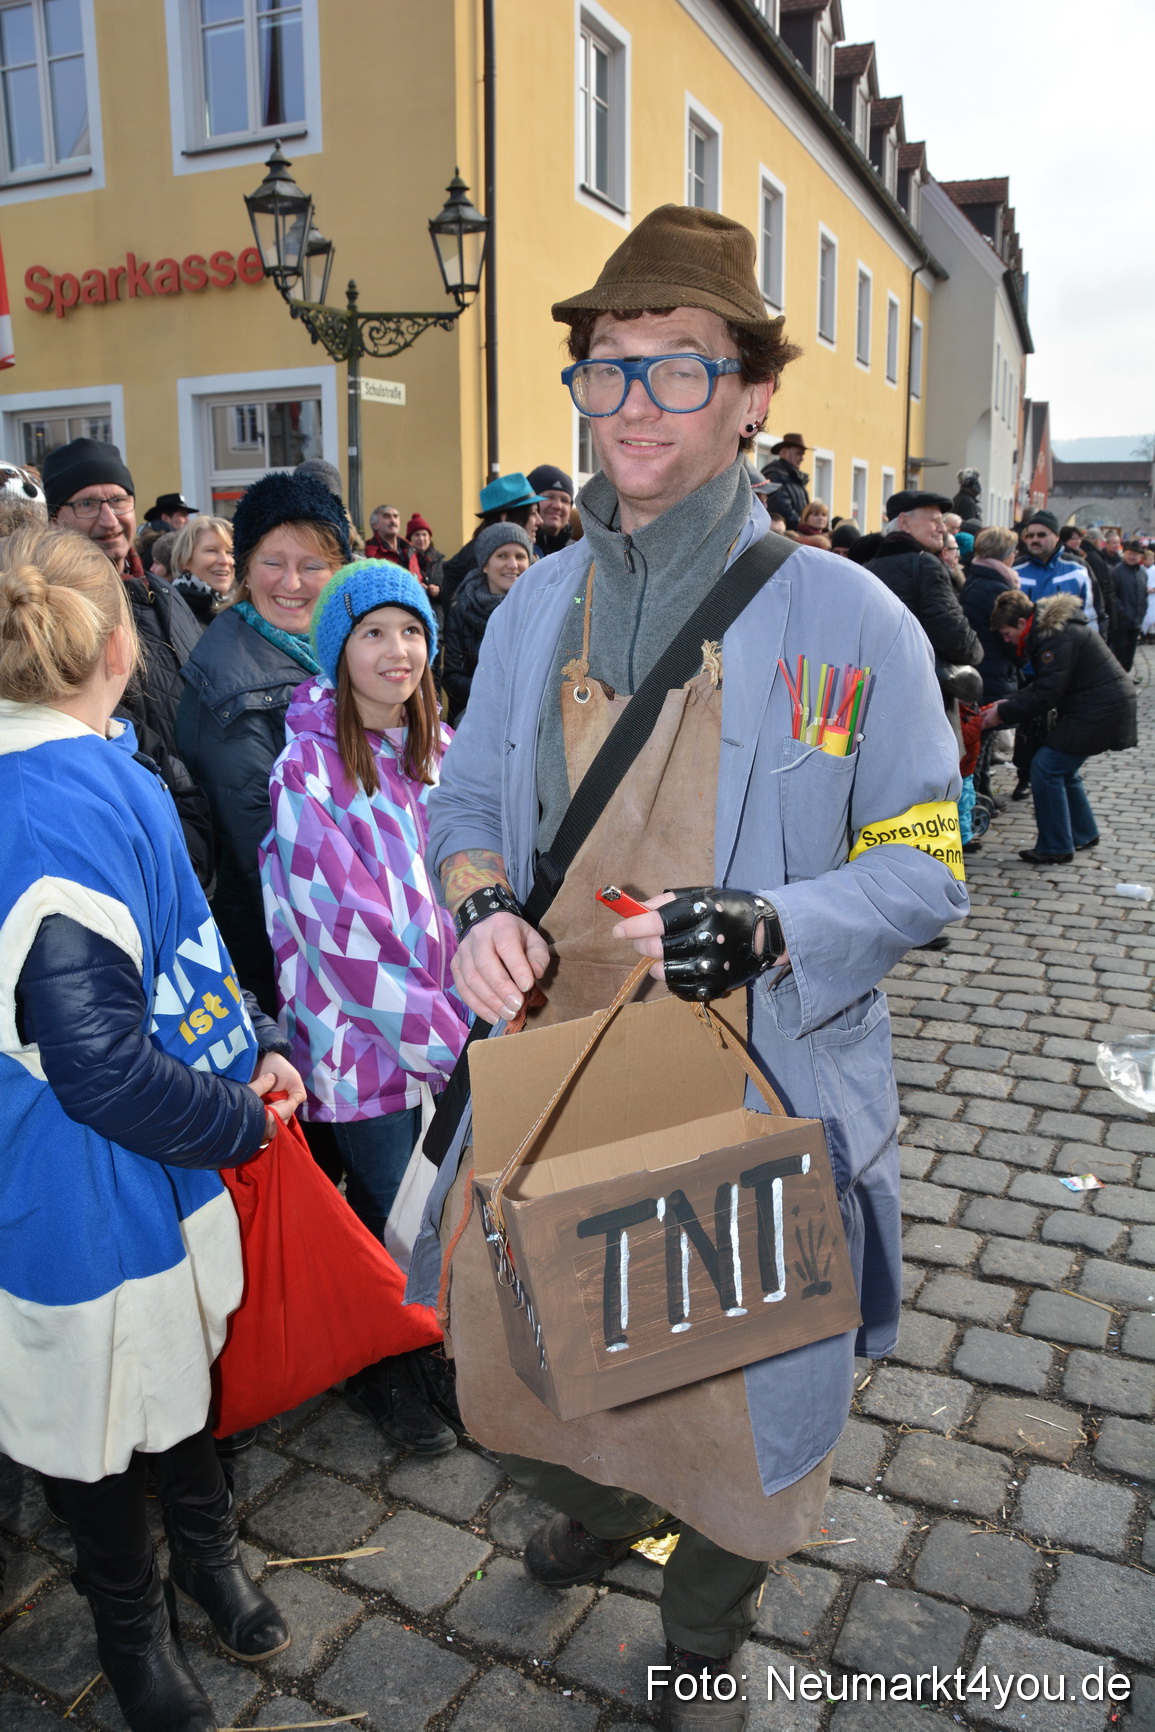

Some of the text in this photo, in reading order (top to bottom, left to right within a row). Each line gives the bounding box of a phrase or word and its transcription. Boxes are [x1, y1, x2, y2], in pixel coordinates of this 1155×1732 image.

[24, 247, 266, 318] Sparkasse
[914, 844, 964, 864] Henn
[577, 1153, 811, 1353] TNT
